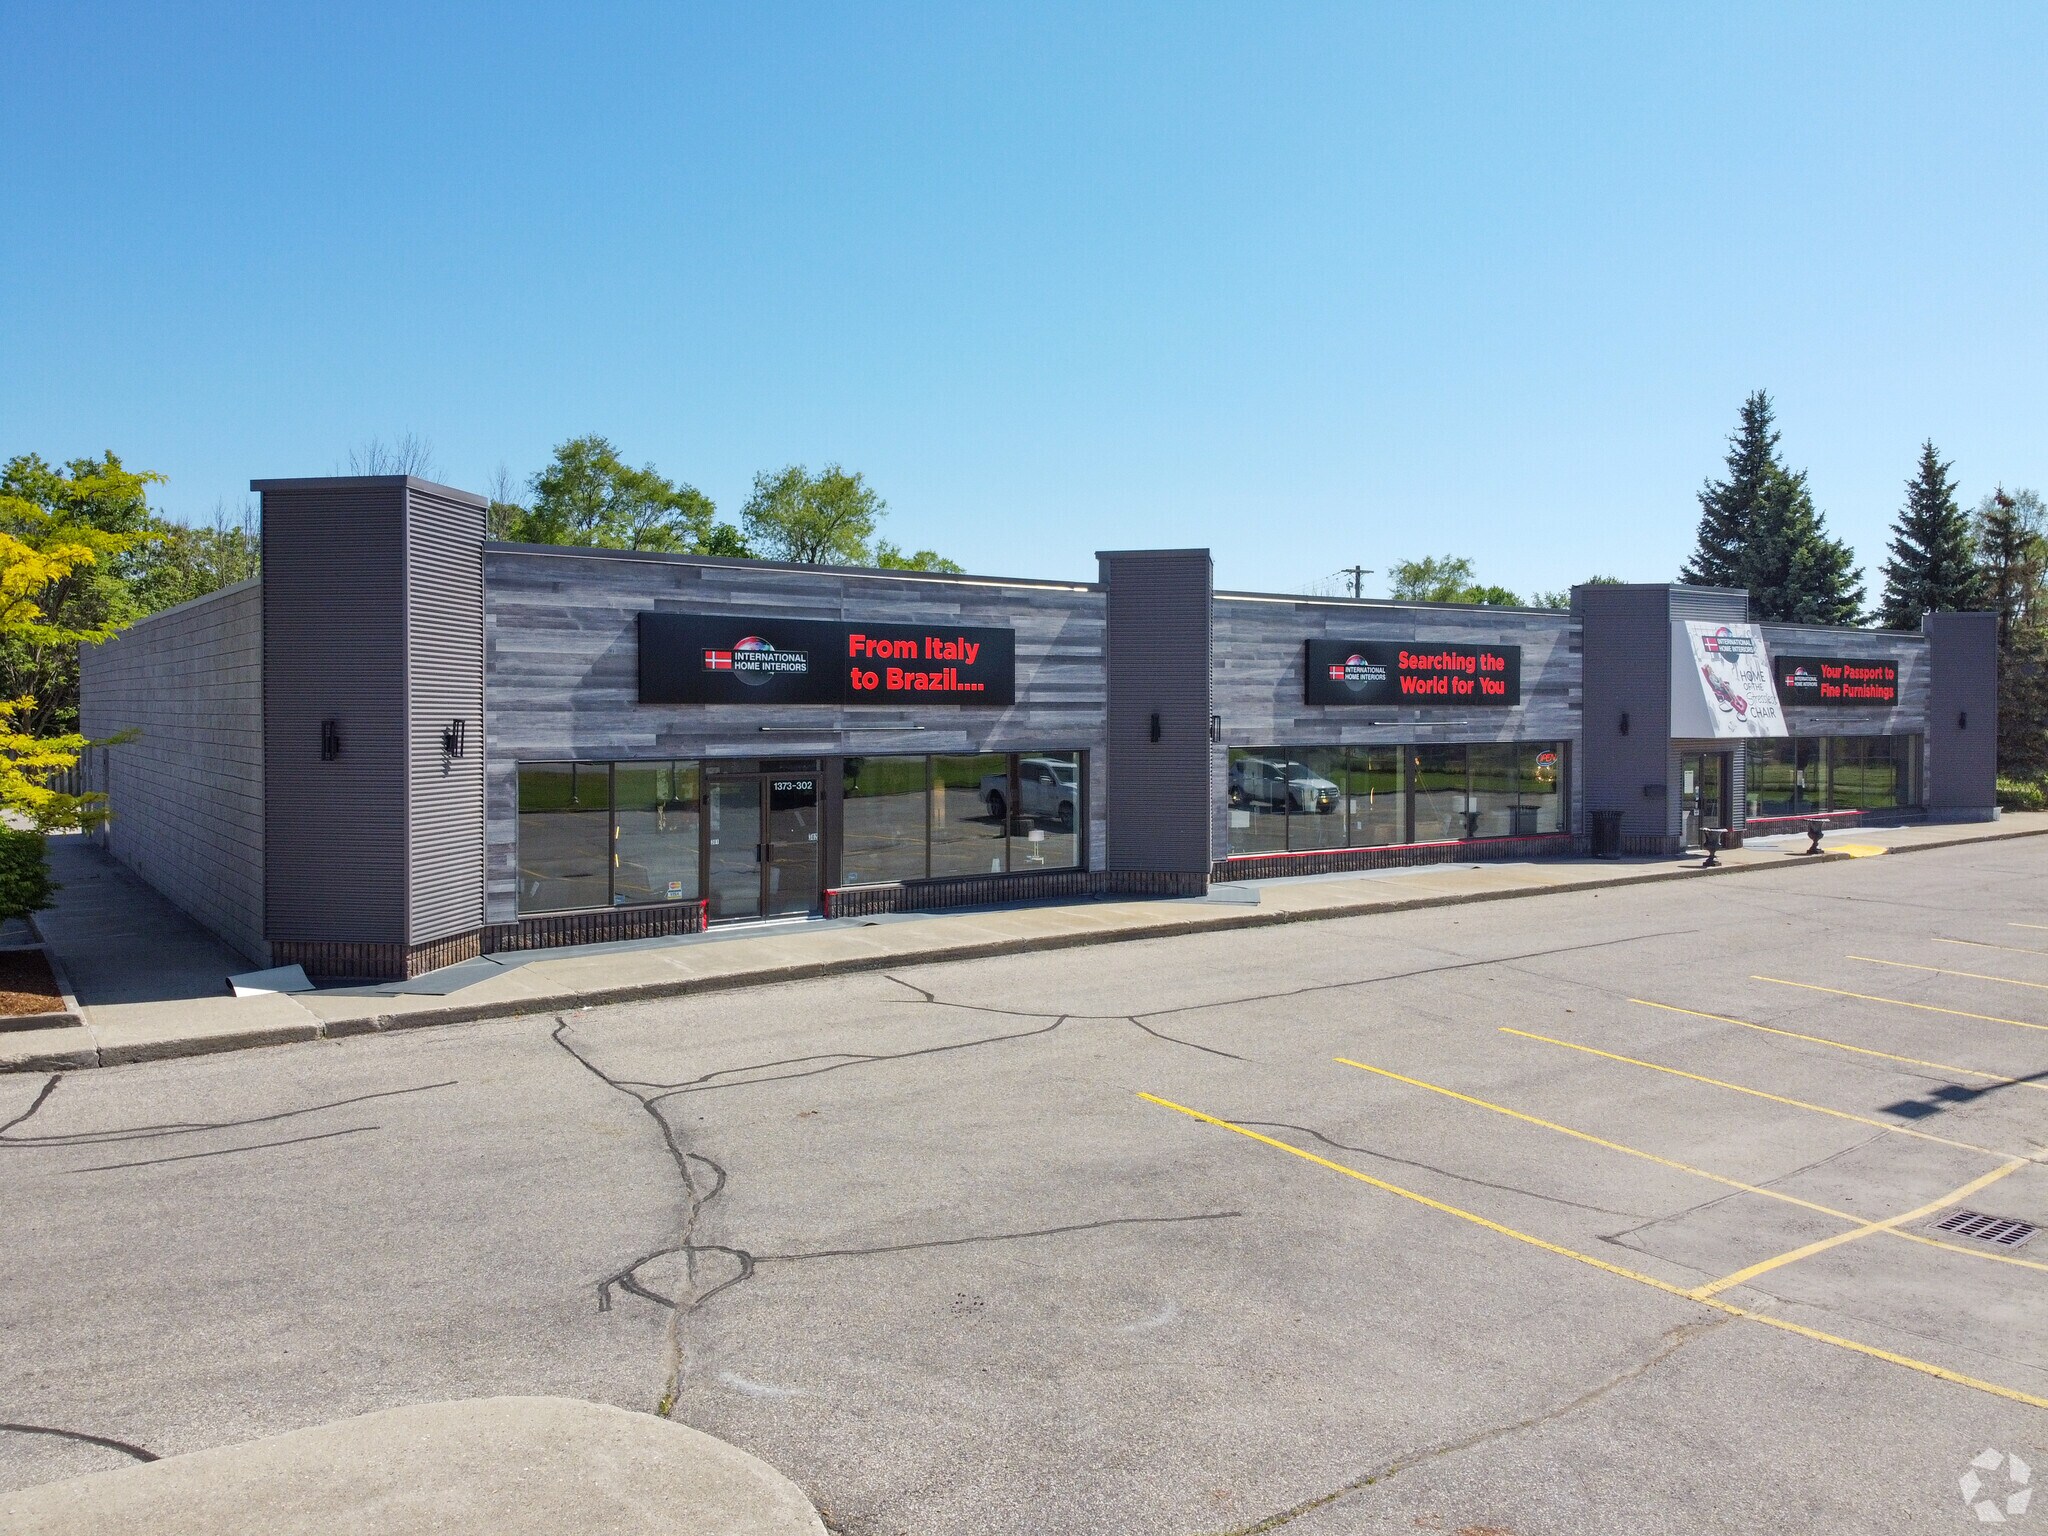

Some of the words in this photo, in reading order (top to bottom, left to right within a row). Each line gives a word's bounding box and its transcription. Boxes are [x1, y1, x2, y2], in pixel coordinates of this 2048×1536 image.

[849, 634, 918, 659] From
[925, 637, 980, 665] Italy
[734, 652, 807, 662] INTERNATIONAL
[1398, 650, 1476, 674] Searching
[1480, 653, 1505, 671] the
[734, 661, 760, 671] HOME
[762, 663, 807, 672] INTERIORS
[1345, 666, 1386, 674] INTERNATIONAL
[851, 667, 879, 690] to
[1345, 673, 1360, 681] HOME
[1740, 670, 1766, 682] HOME
[1821, 664, 1842, 678] Your
[1844, 665, 1883, 682] Passport
[1885, 667, 1895, 680] to
[1400, 676, 1448, 694] World
[1452, 676, 1475, 694] for
[1479, 677, 1505, 694] You
[1743, 682, 1752, 691] OF
[1752, 682, 1764, 691] THE
[1821, 683, 1841, 697] Fine
[1843, 684, 1895, 700] Furnishings
[1750, 706, 1777, 719] CHAIR
[774, 781, 813, 791] 1373-302
